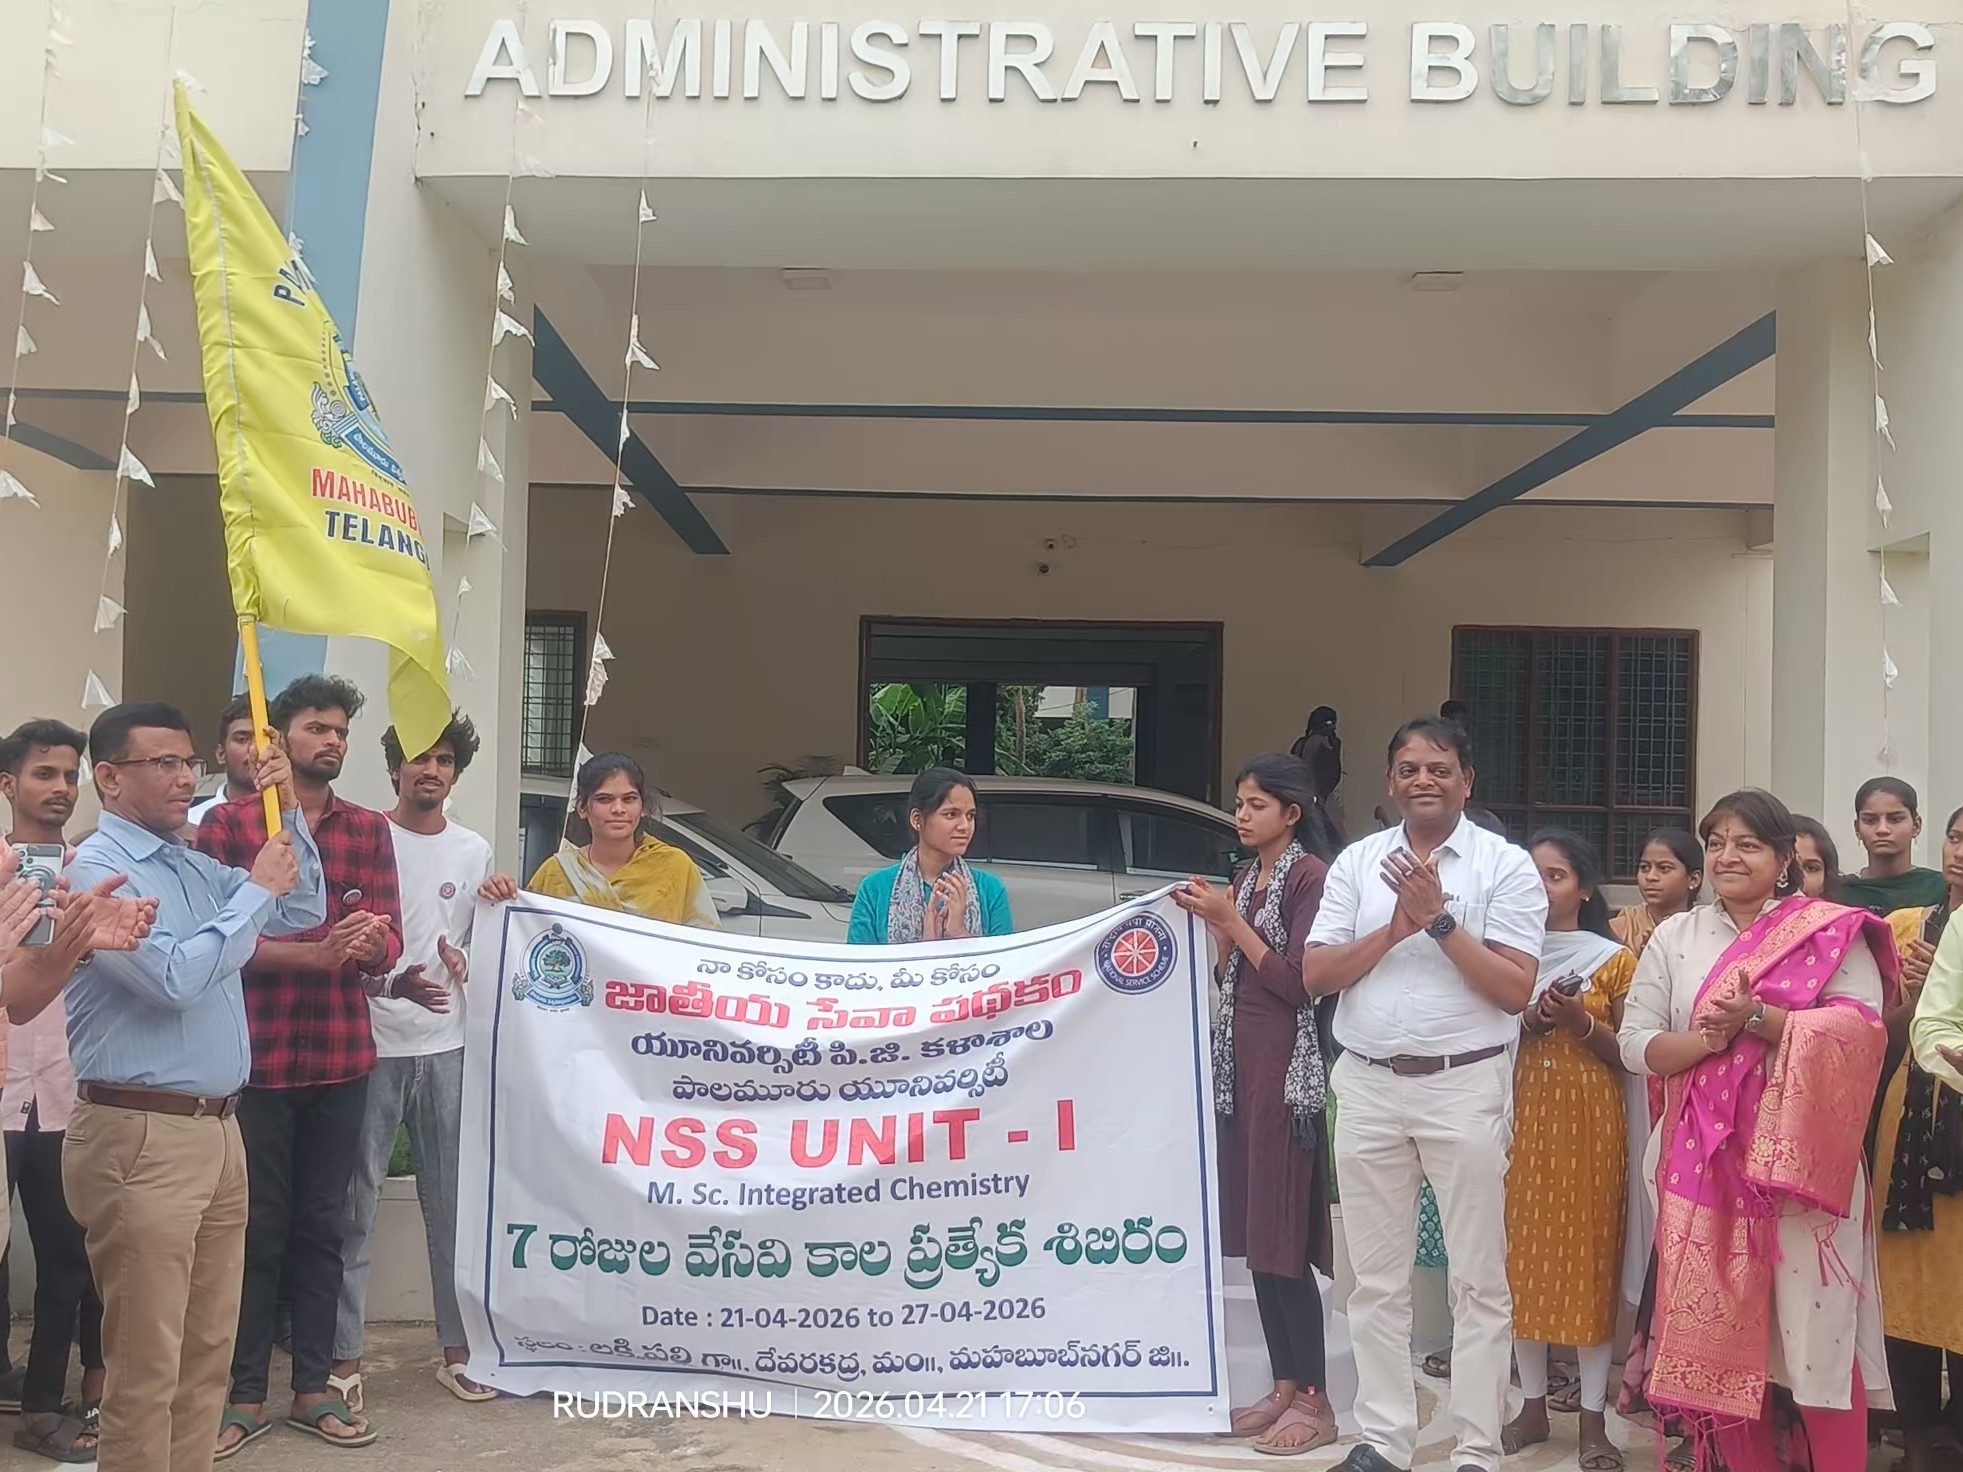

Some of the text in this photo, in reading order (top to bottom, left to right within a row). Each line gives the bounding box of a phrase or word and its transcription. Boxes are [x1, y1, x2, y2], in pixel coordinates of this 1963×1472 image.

[464, 17, 1939, 106] ADMINISTRATIVE BUILDING
[312, 468, 422, 536] MAHABUB
[697, 958, 731, 975] నా
[737, 960, 808, 987] కోసం
[890, 967, 924, 989] మీ
[930, 962, 1000, 985] కోసం
[1125, 976, 1152, 987] SERVICE
[1150, 955, 1169, 980] SCHEME
[604, 968, 1082, 1030] జాతీయ సేవా పథకం
[631, 1019, 1054, 1074] యూనివర్సిటీ పి.జి. కళాశాల
[673, 1051, 1009, 1102] పాలమూరు యూనివర్సిటీ
[601, 1112, 758, 1170] NSS
[789, 1108, 980, 1169] UNIT
[1056, 1099, 1076, 1151] I
[647, 1172, 1030, 1211] M. Sc. Integrated Chemistry
[507, 1215, 1188, 1290] 7 రోజుల వేసవి కాల ప్రత్యేక శిబిరం
[641, 1305, 699, 1328] Date
[720, 1306, 861, 1329] 21-04-2026
[867, 1307, 894, 1328] to
[901, 1297, 1046, 1326] 27-04-2026
